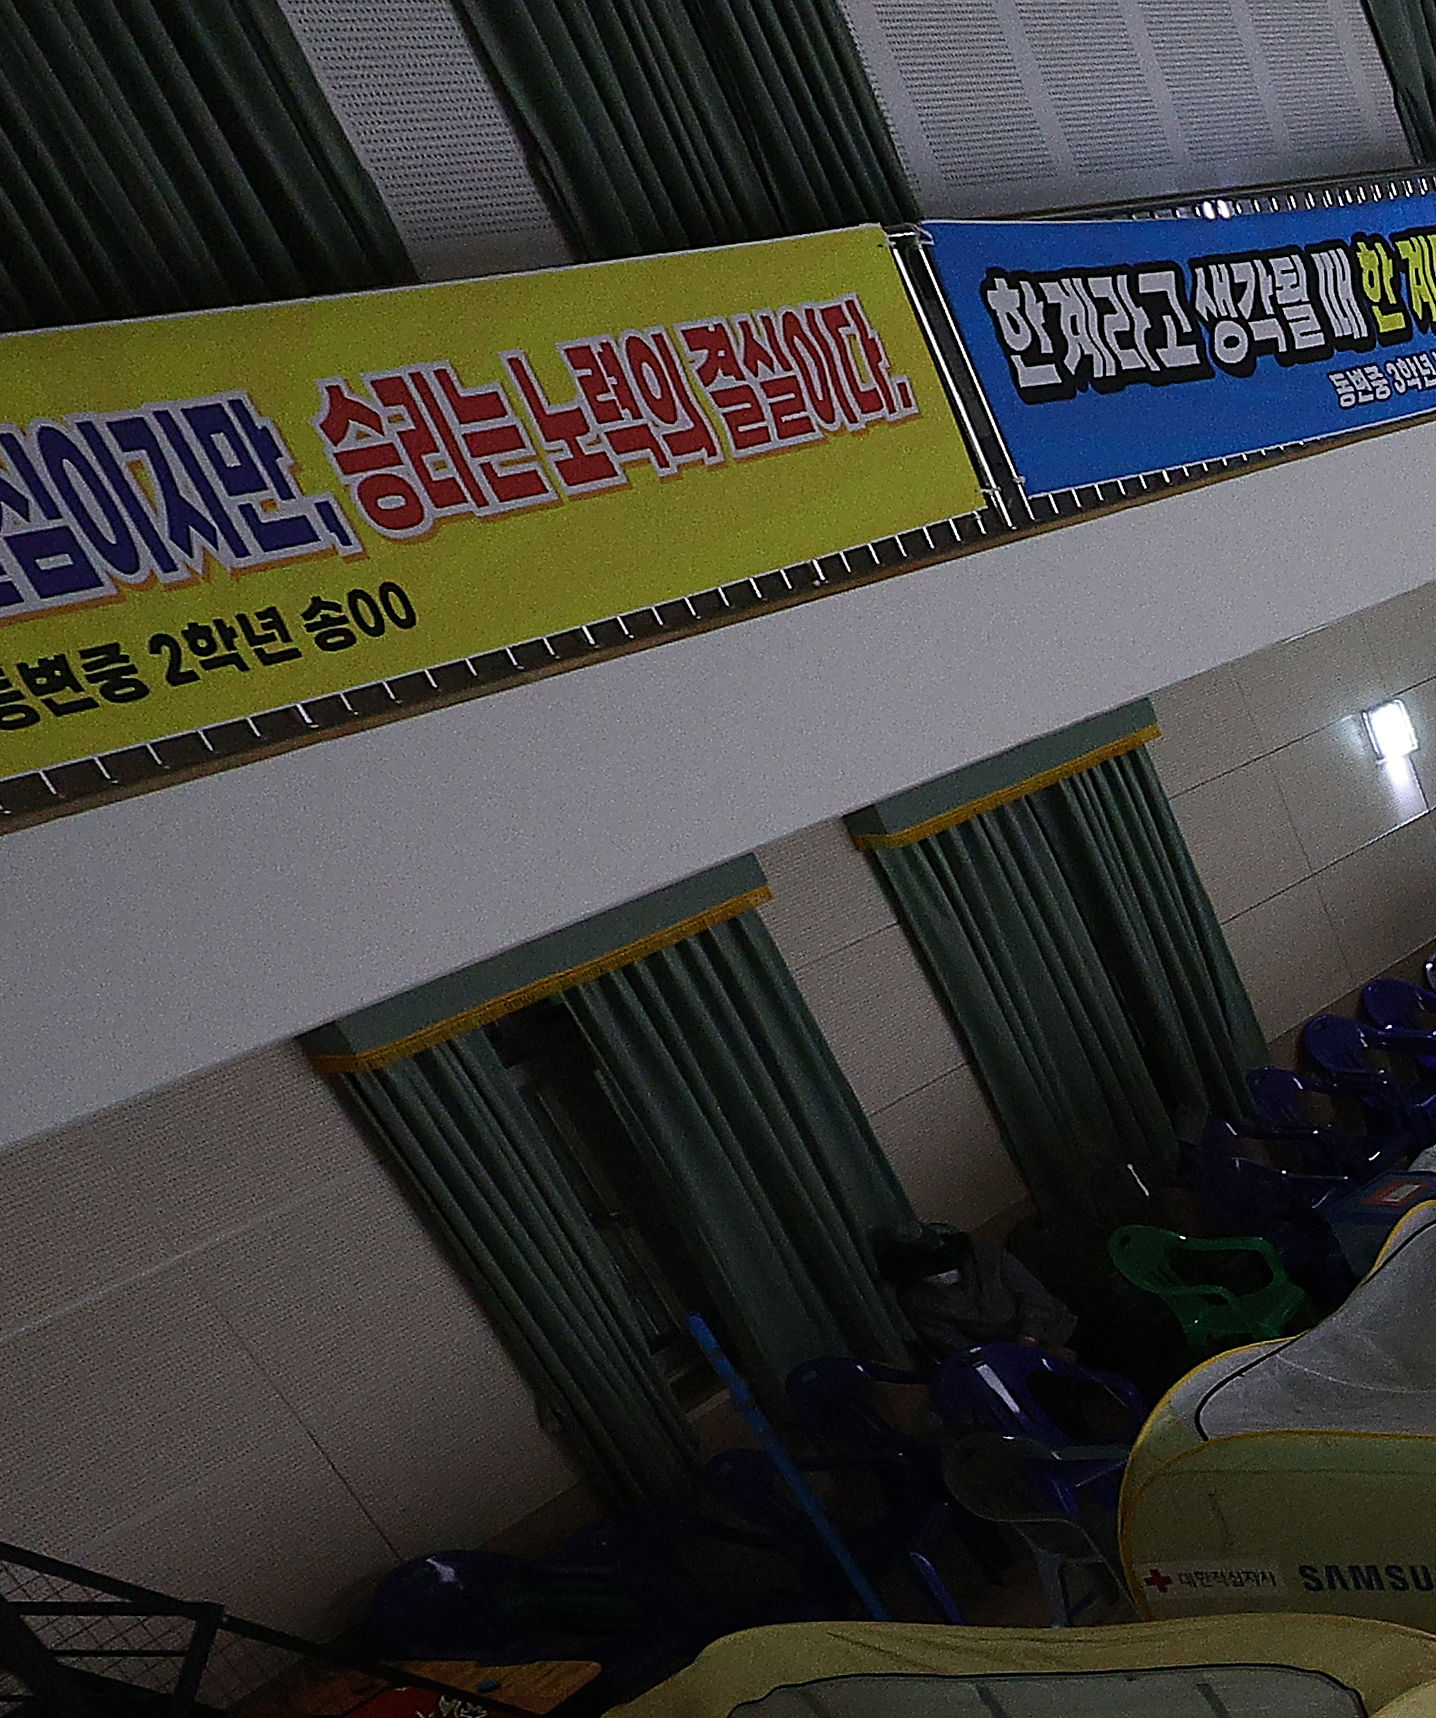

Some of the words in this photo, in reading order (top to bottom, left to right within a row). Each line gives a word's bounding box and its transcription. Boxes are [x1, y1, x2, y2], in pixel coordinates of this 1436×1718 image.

[986, 270, 1201, 389] 한계라고
[1194, 253, 1326, 365] 생각될
[1311, 247, 1367, 340] 때
[1357, 241, 1407, 334] 한
[1328, 365, 1392, 408] 동변중
[0, 400, 350, 605] 심이지만,
[318, 364, 556, 533] 승리는
[529, 332, 718, 491] 노력의
[680, 296, 915, 452] 결실이다.
[147, 607, 299, 687] 2학년
[1178, 1568, 1277, 1589] 대한적십자사
